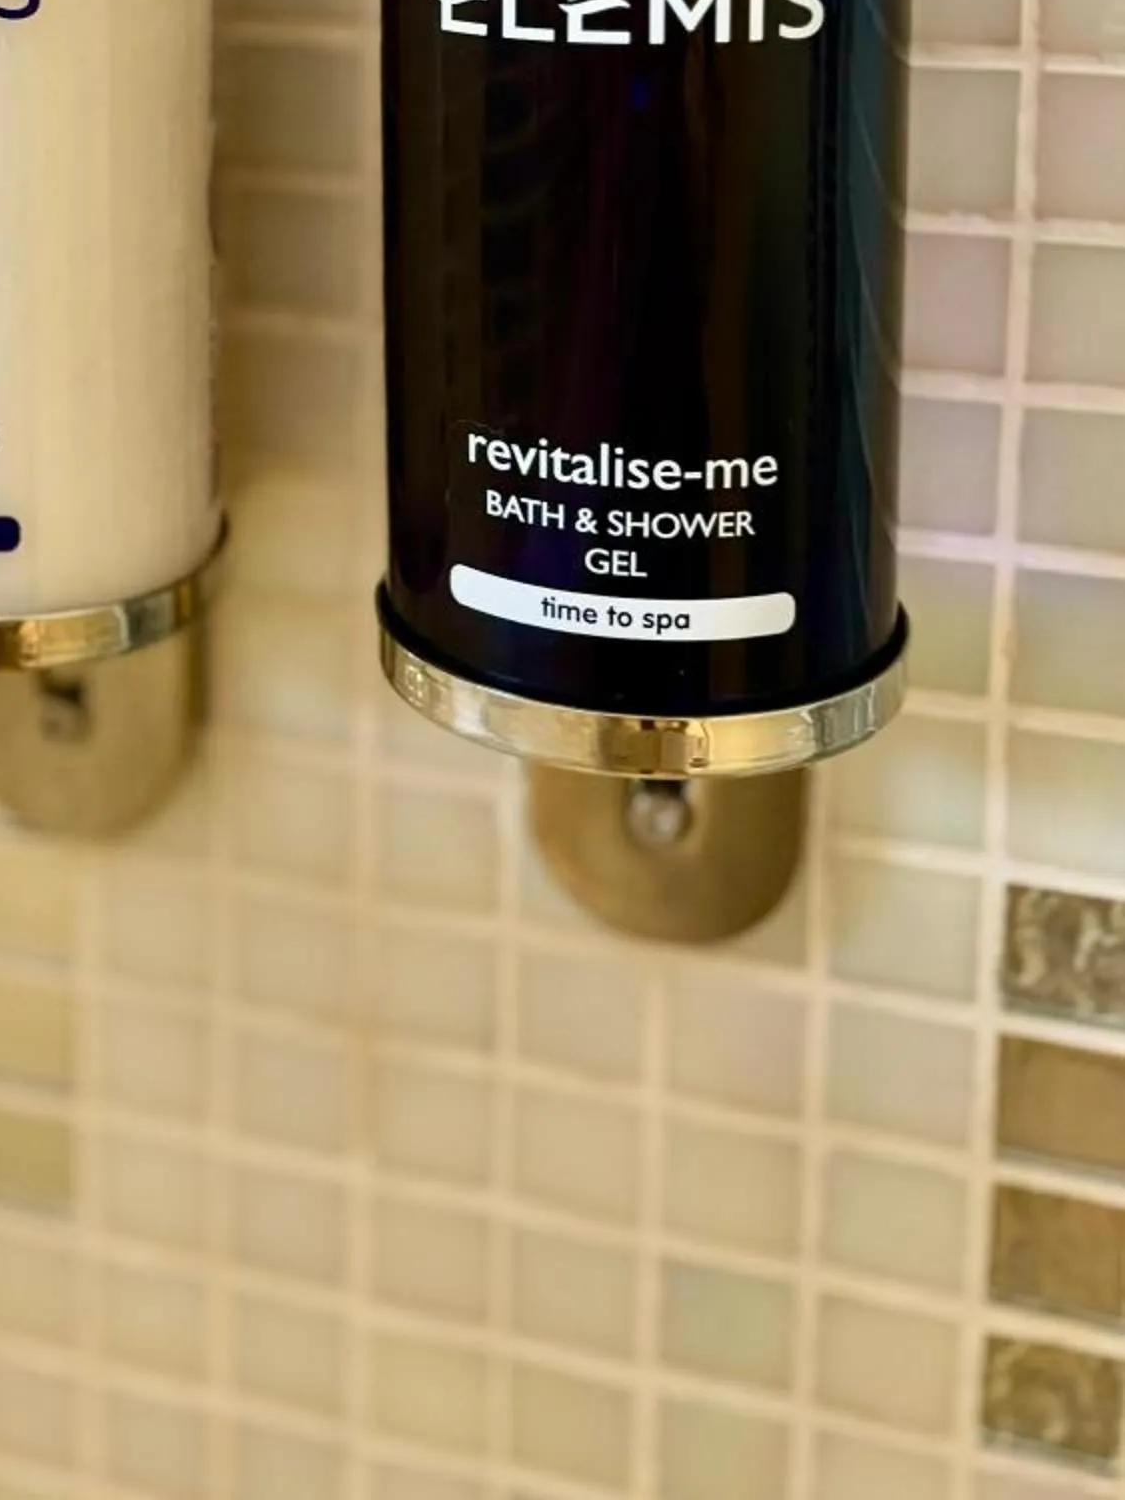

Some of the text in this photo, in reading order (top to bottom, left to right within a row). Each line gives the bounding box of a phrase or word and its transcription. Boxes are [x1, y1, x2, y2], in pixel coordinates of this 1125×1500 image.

[467, 432, 780, 492] revitalise-me
[485, 488, 757, 540] BATH & SHOWER
[583, 547, 649, 579] GEL
[540, 596, 692, 635] time to spa
